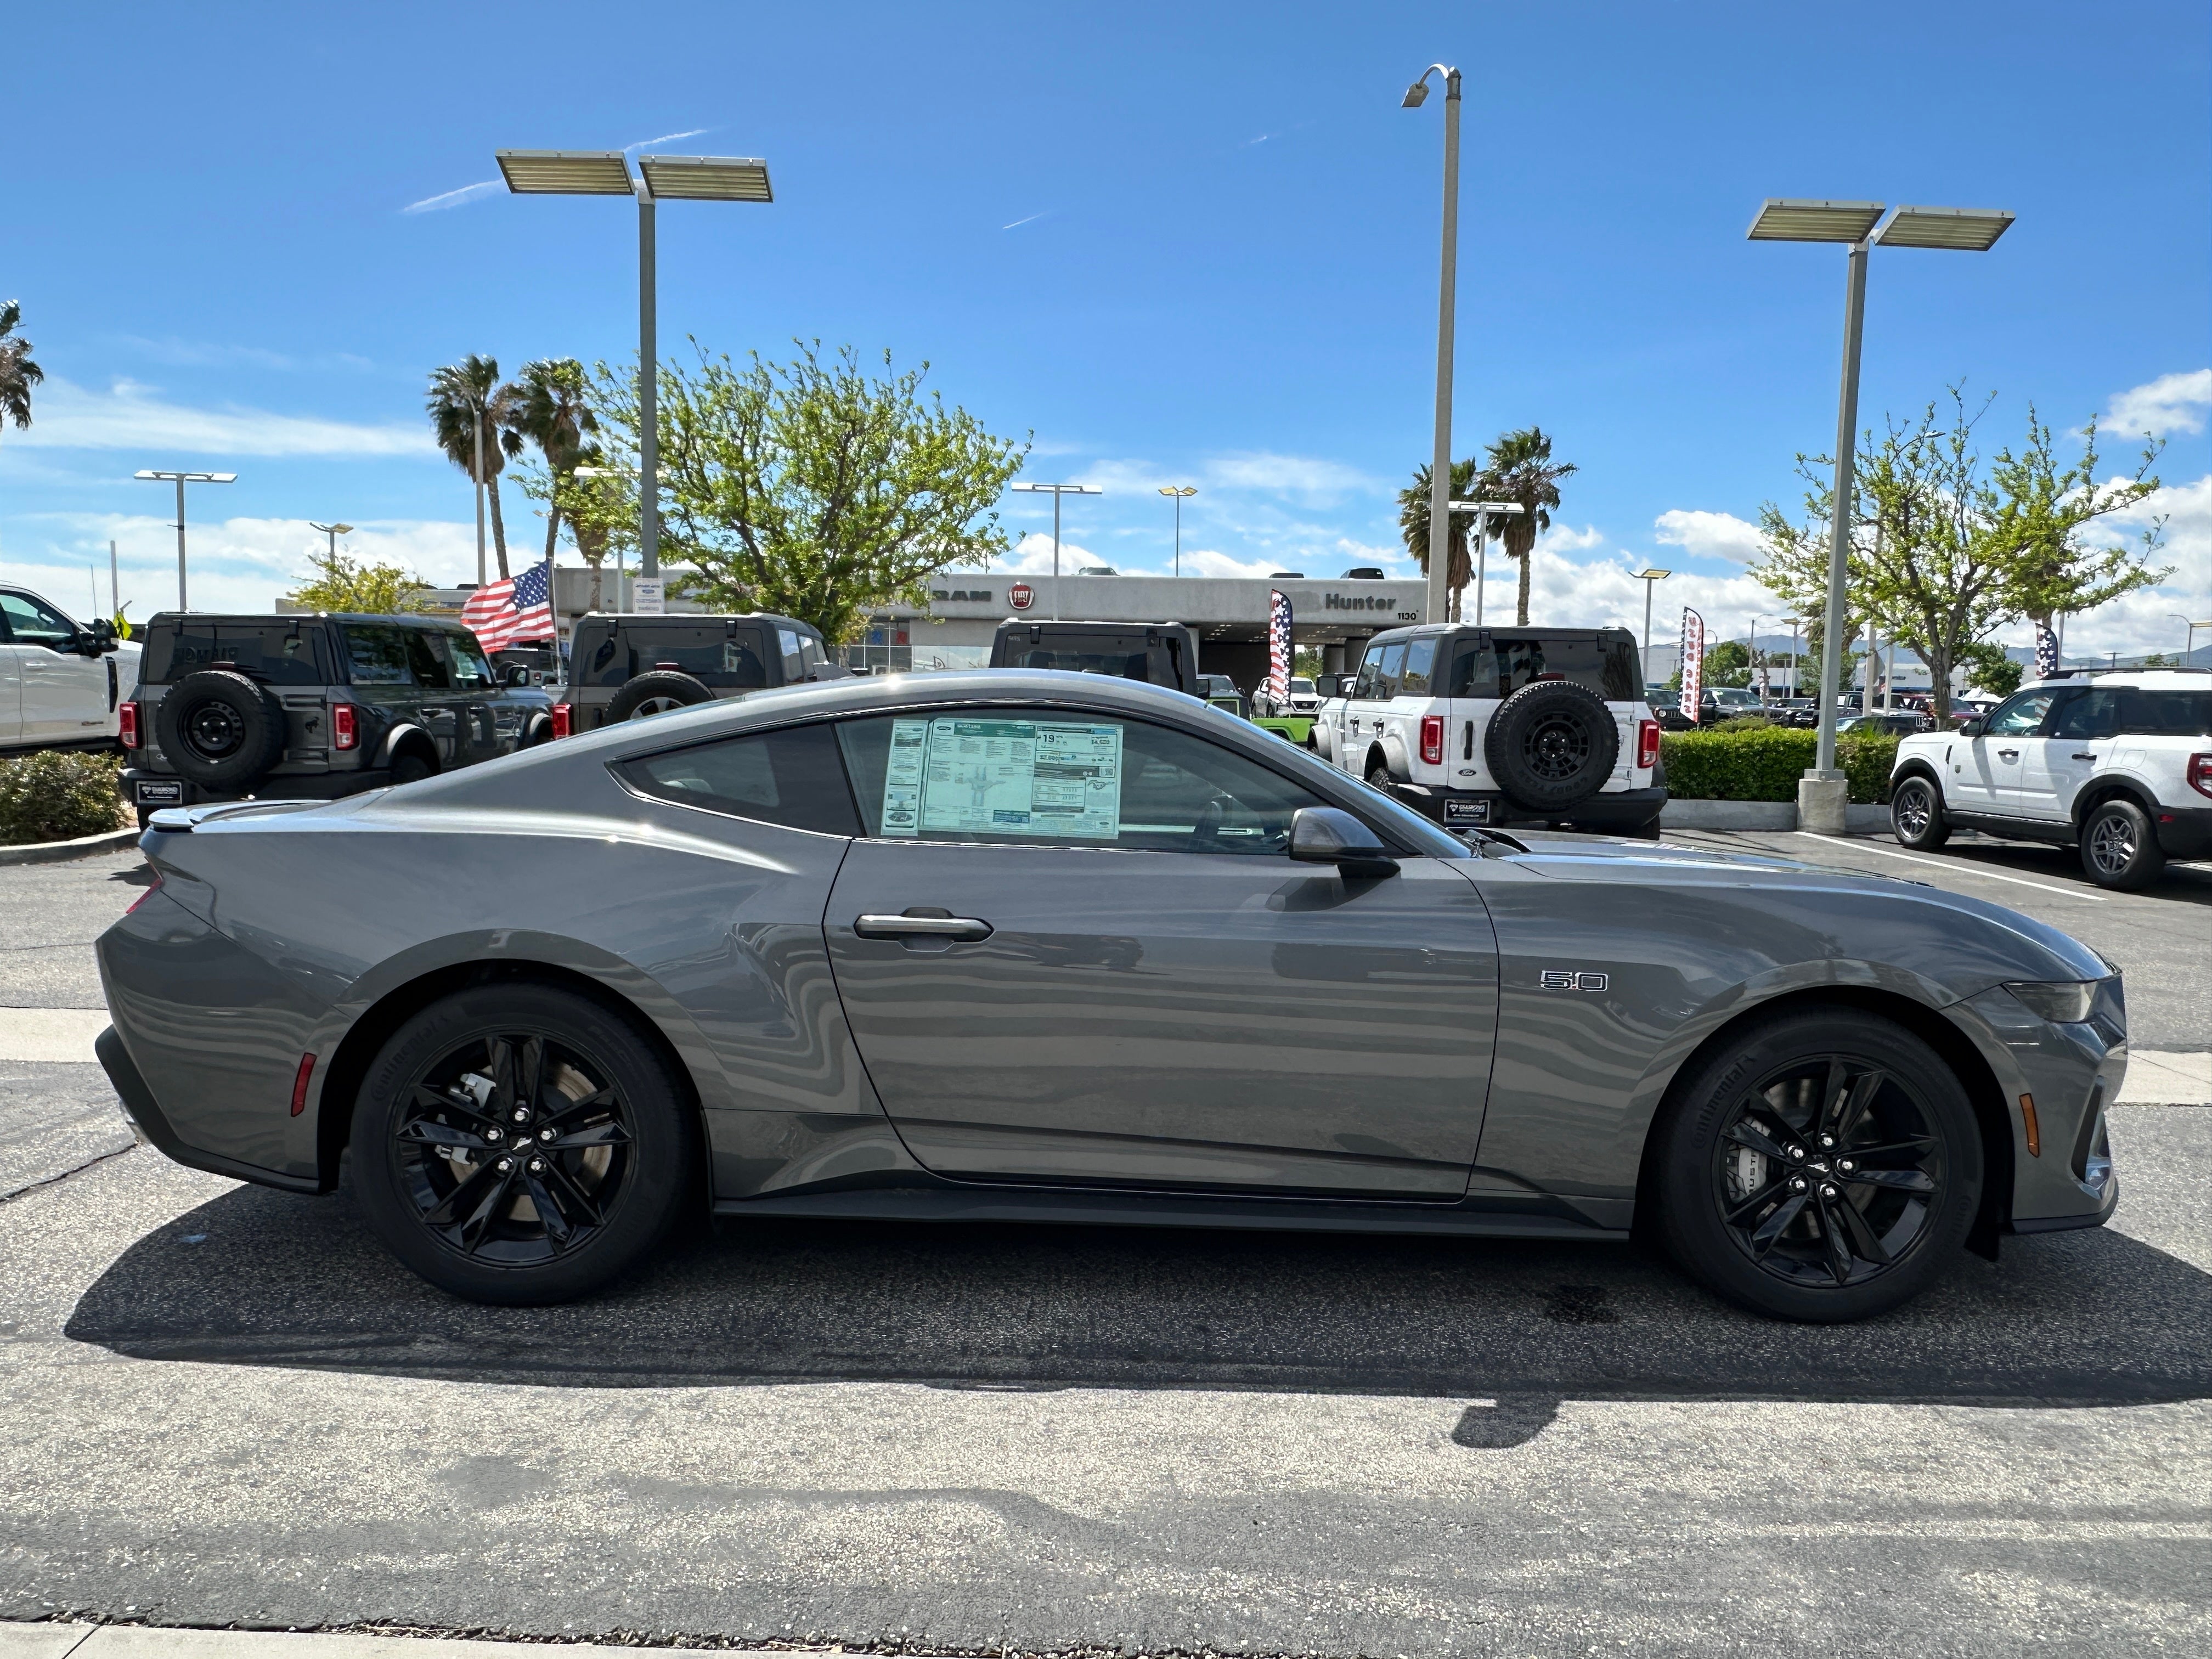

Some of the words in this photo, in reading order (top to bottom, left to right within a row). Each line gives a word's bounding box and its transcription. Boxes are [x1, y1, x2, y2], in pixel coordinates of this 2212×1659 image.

[932, 590, 992, 602] RAM
[1325, 593, 1397, 611] Hunter
[1397, 612, 1417, 620] 1130
[1043, 734, 1055, 743] 19
[1540, 970, 1609, 991] 5.0
[1691, 1062, 1747, 1149] Continental
